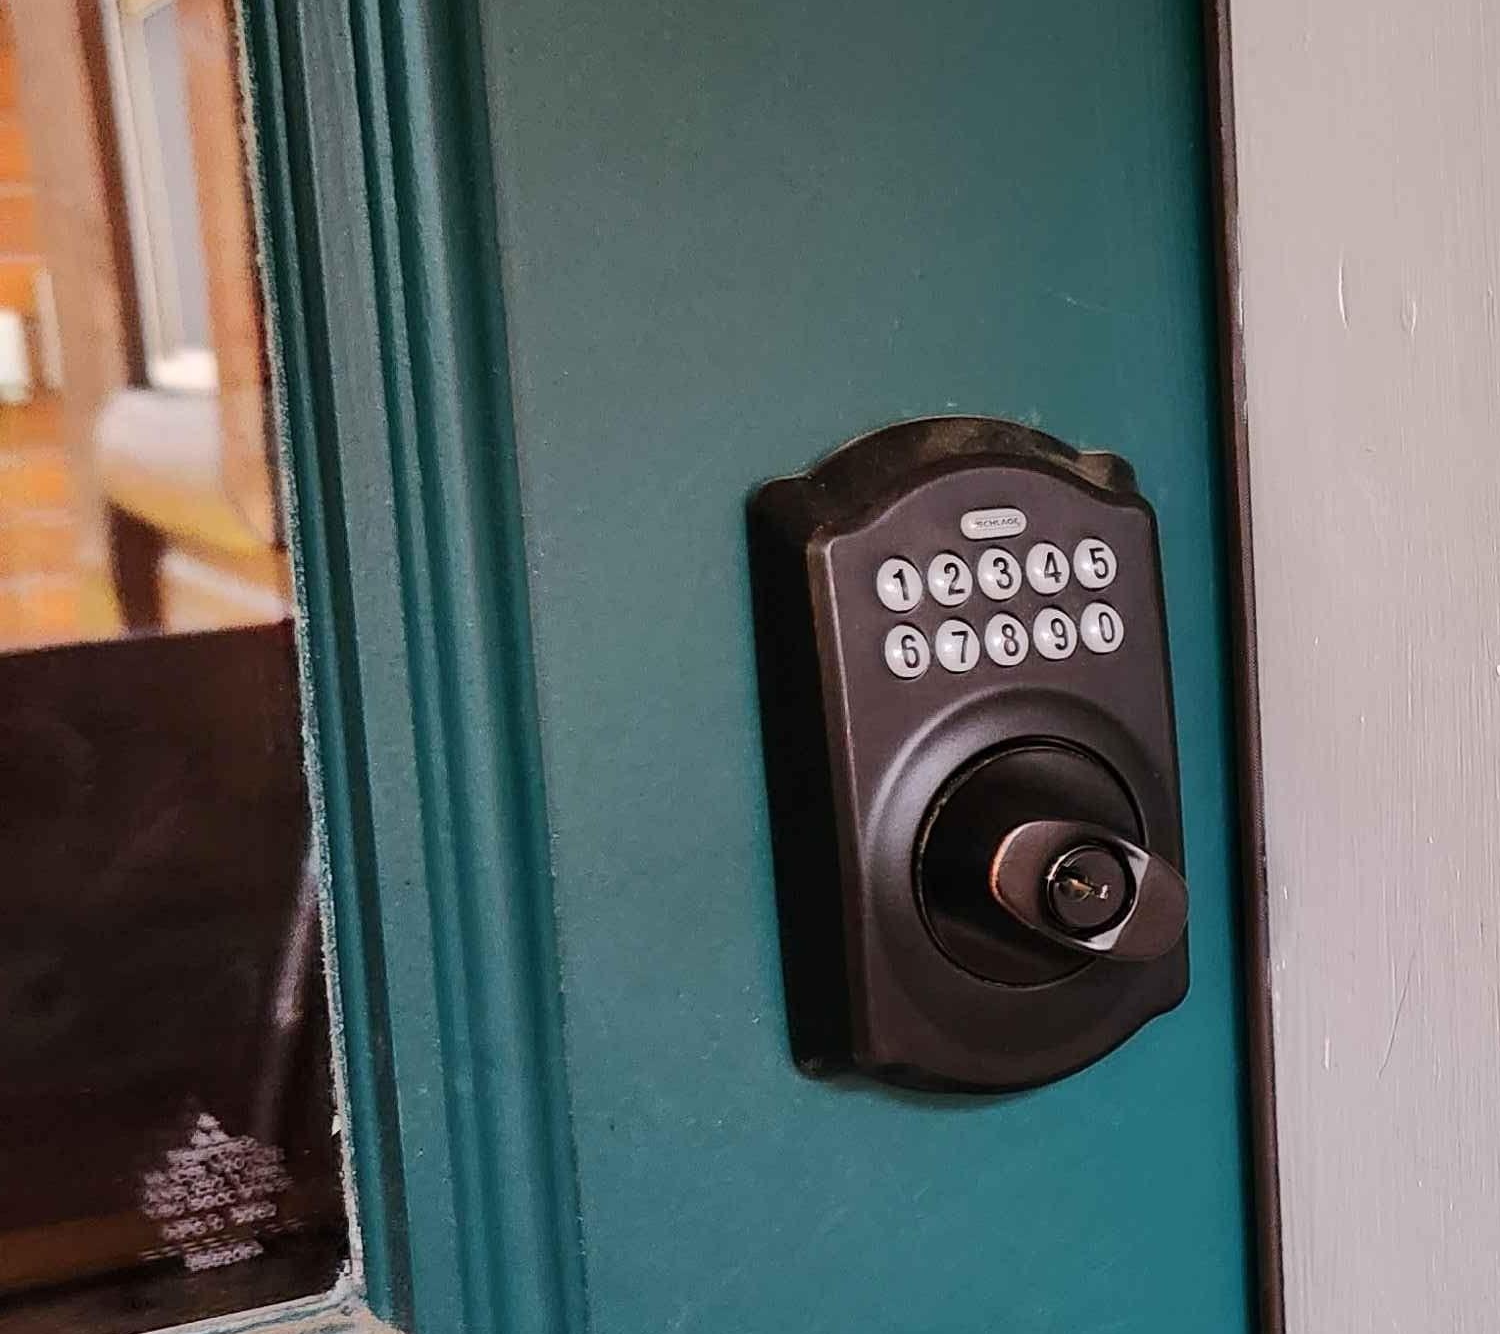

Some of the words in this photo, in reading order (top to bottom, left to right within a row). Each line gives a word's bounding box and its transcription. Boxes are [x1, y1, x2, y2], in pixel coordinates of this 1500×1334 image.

[892, 568, 909, 601] 1
[943, 563, 965, 596] 2
[992, 556, 1013, 590] 3
[1043, 551, 1062, 584] 4
[1088, 547, 1109, 579] 5
[900, 634, 920, 668] 6
[951, 630, 969, 664] 7
[1001, 623, 1019, 656] 8
[1050, 617, 1069, 650] 9
[1098, 611, 1115, 644] 0
